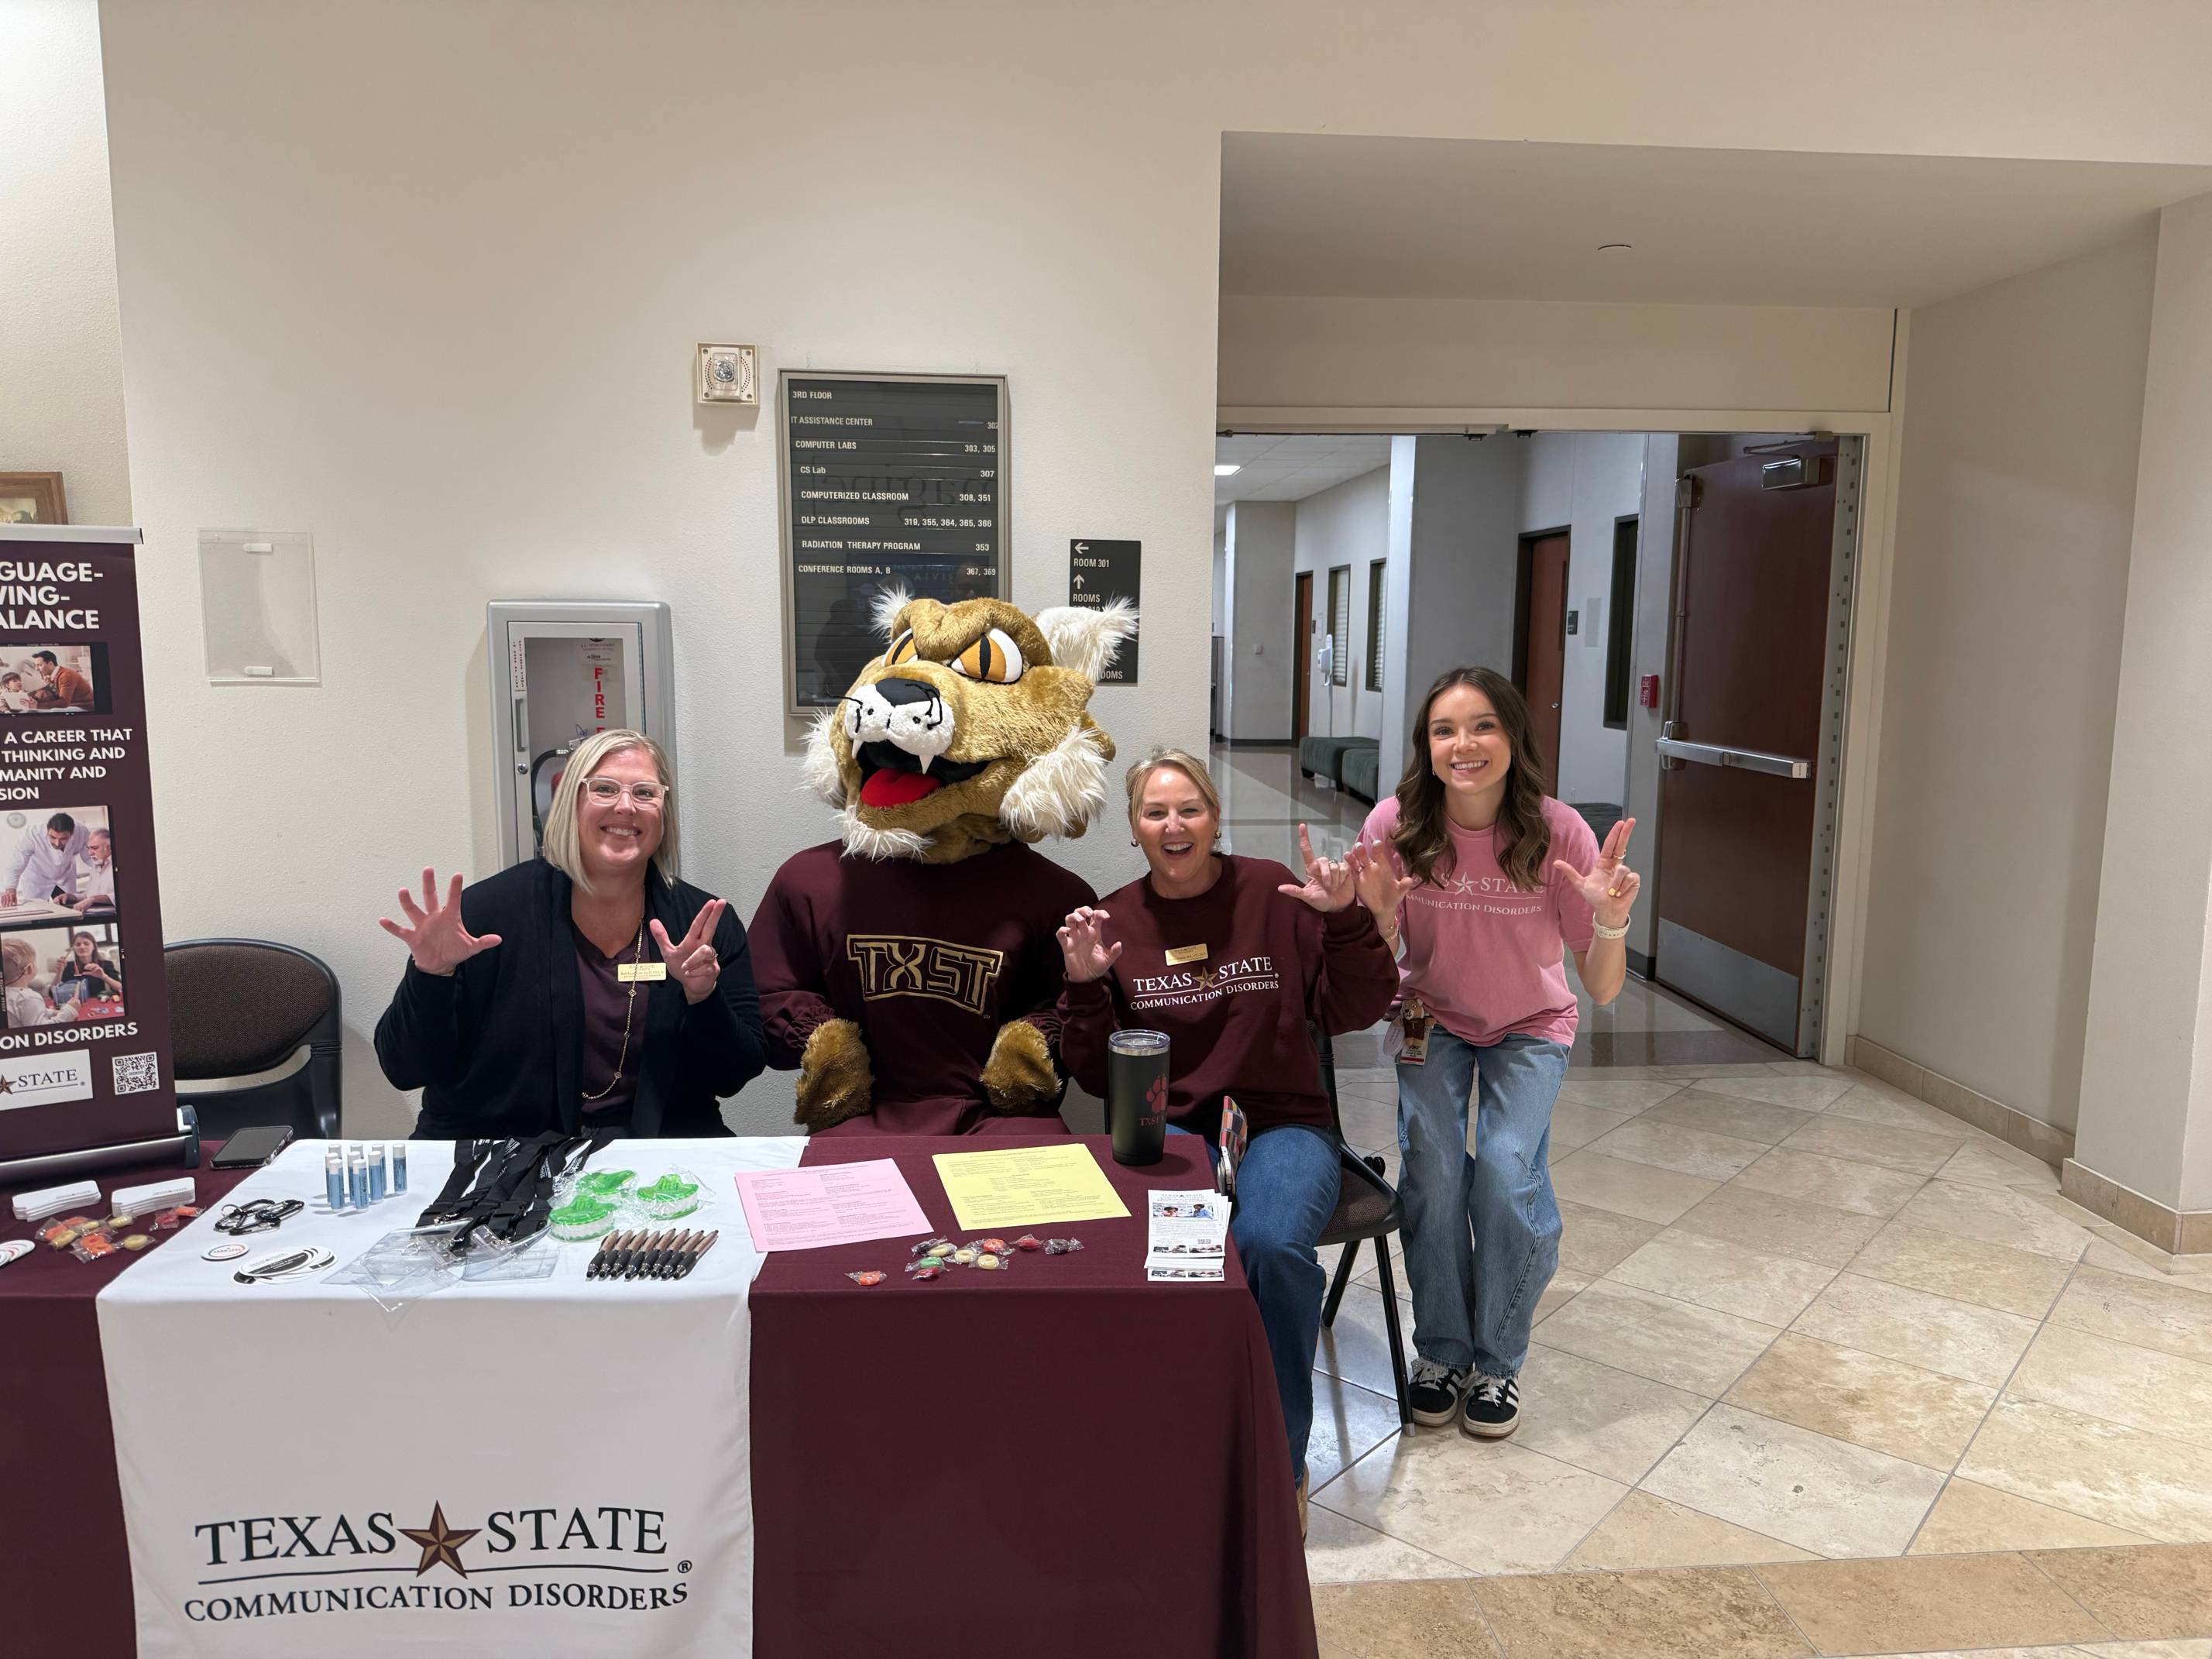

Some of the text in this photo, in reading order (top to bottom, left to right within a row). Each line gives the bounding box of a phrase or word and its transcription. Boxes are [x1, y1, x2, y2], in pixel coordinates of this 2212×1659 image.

[792, 390, 833, 400] 3RD FLOOR
[790, 416, 798, 424] IT
[799, 417, 844, 426] ASSISTANCE
[845, 417, 873, 427] CENTER
[795, 440, 996, 453] COMPUTER LABS 303, 305
[800, 465, 811, 474] CS
[812, 466, 826, 475] Lab
[801, 490, 860, 500] COMPUTERIZED
[862, 492, 909, 501] CLASSROOM
[959, 493, 976, 503] 308,
[801, 516, 816, 524] DLP
[818, 517, 870, 525] CLASSROOMS
[802, 540, 843, 549] RADIATION
[847, 541, 881, 550] THERAPY
[883, 542, 921, 551] PROGRAM
[1073, 558, 1110, 568] ROOM 301
[0, 561, 104, 582] GUAGE-
[798, 565, 844, 574] CONFERENCE
[847, 565, 873, 575] ROOMS
[874, 566, 883, 575] A,
[1073, 593, 1101, 603] ROOMS
[1100, 670, 1123, 680] OOMS
[594, 667, 606, 720] FIRE
[4, 728, 132, 744] A CAREER THAT
[2, 747, 125, 763] THINKING AND
[69, 765, 107, 779] AND
[1483, 904, 1543, 915] DISORDERS
[854, 941, 996, 1006] TXST
[1132, 957, 1273, 992] TEXAS STATE
[1130, 981, 1279, 1010] COMMUNICATION DISORDERS
[0, 1022, 139, 1050] ON DISORDERS
[18, 1068, 78, 1087] STATE
[194, 1506, 668, 1566] TEXAS STATE
[184, 1581, 688, 1622] COMMUNICATION DISORDERS
